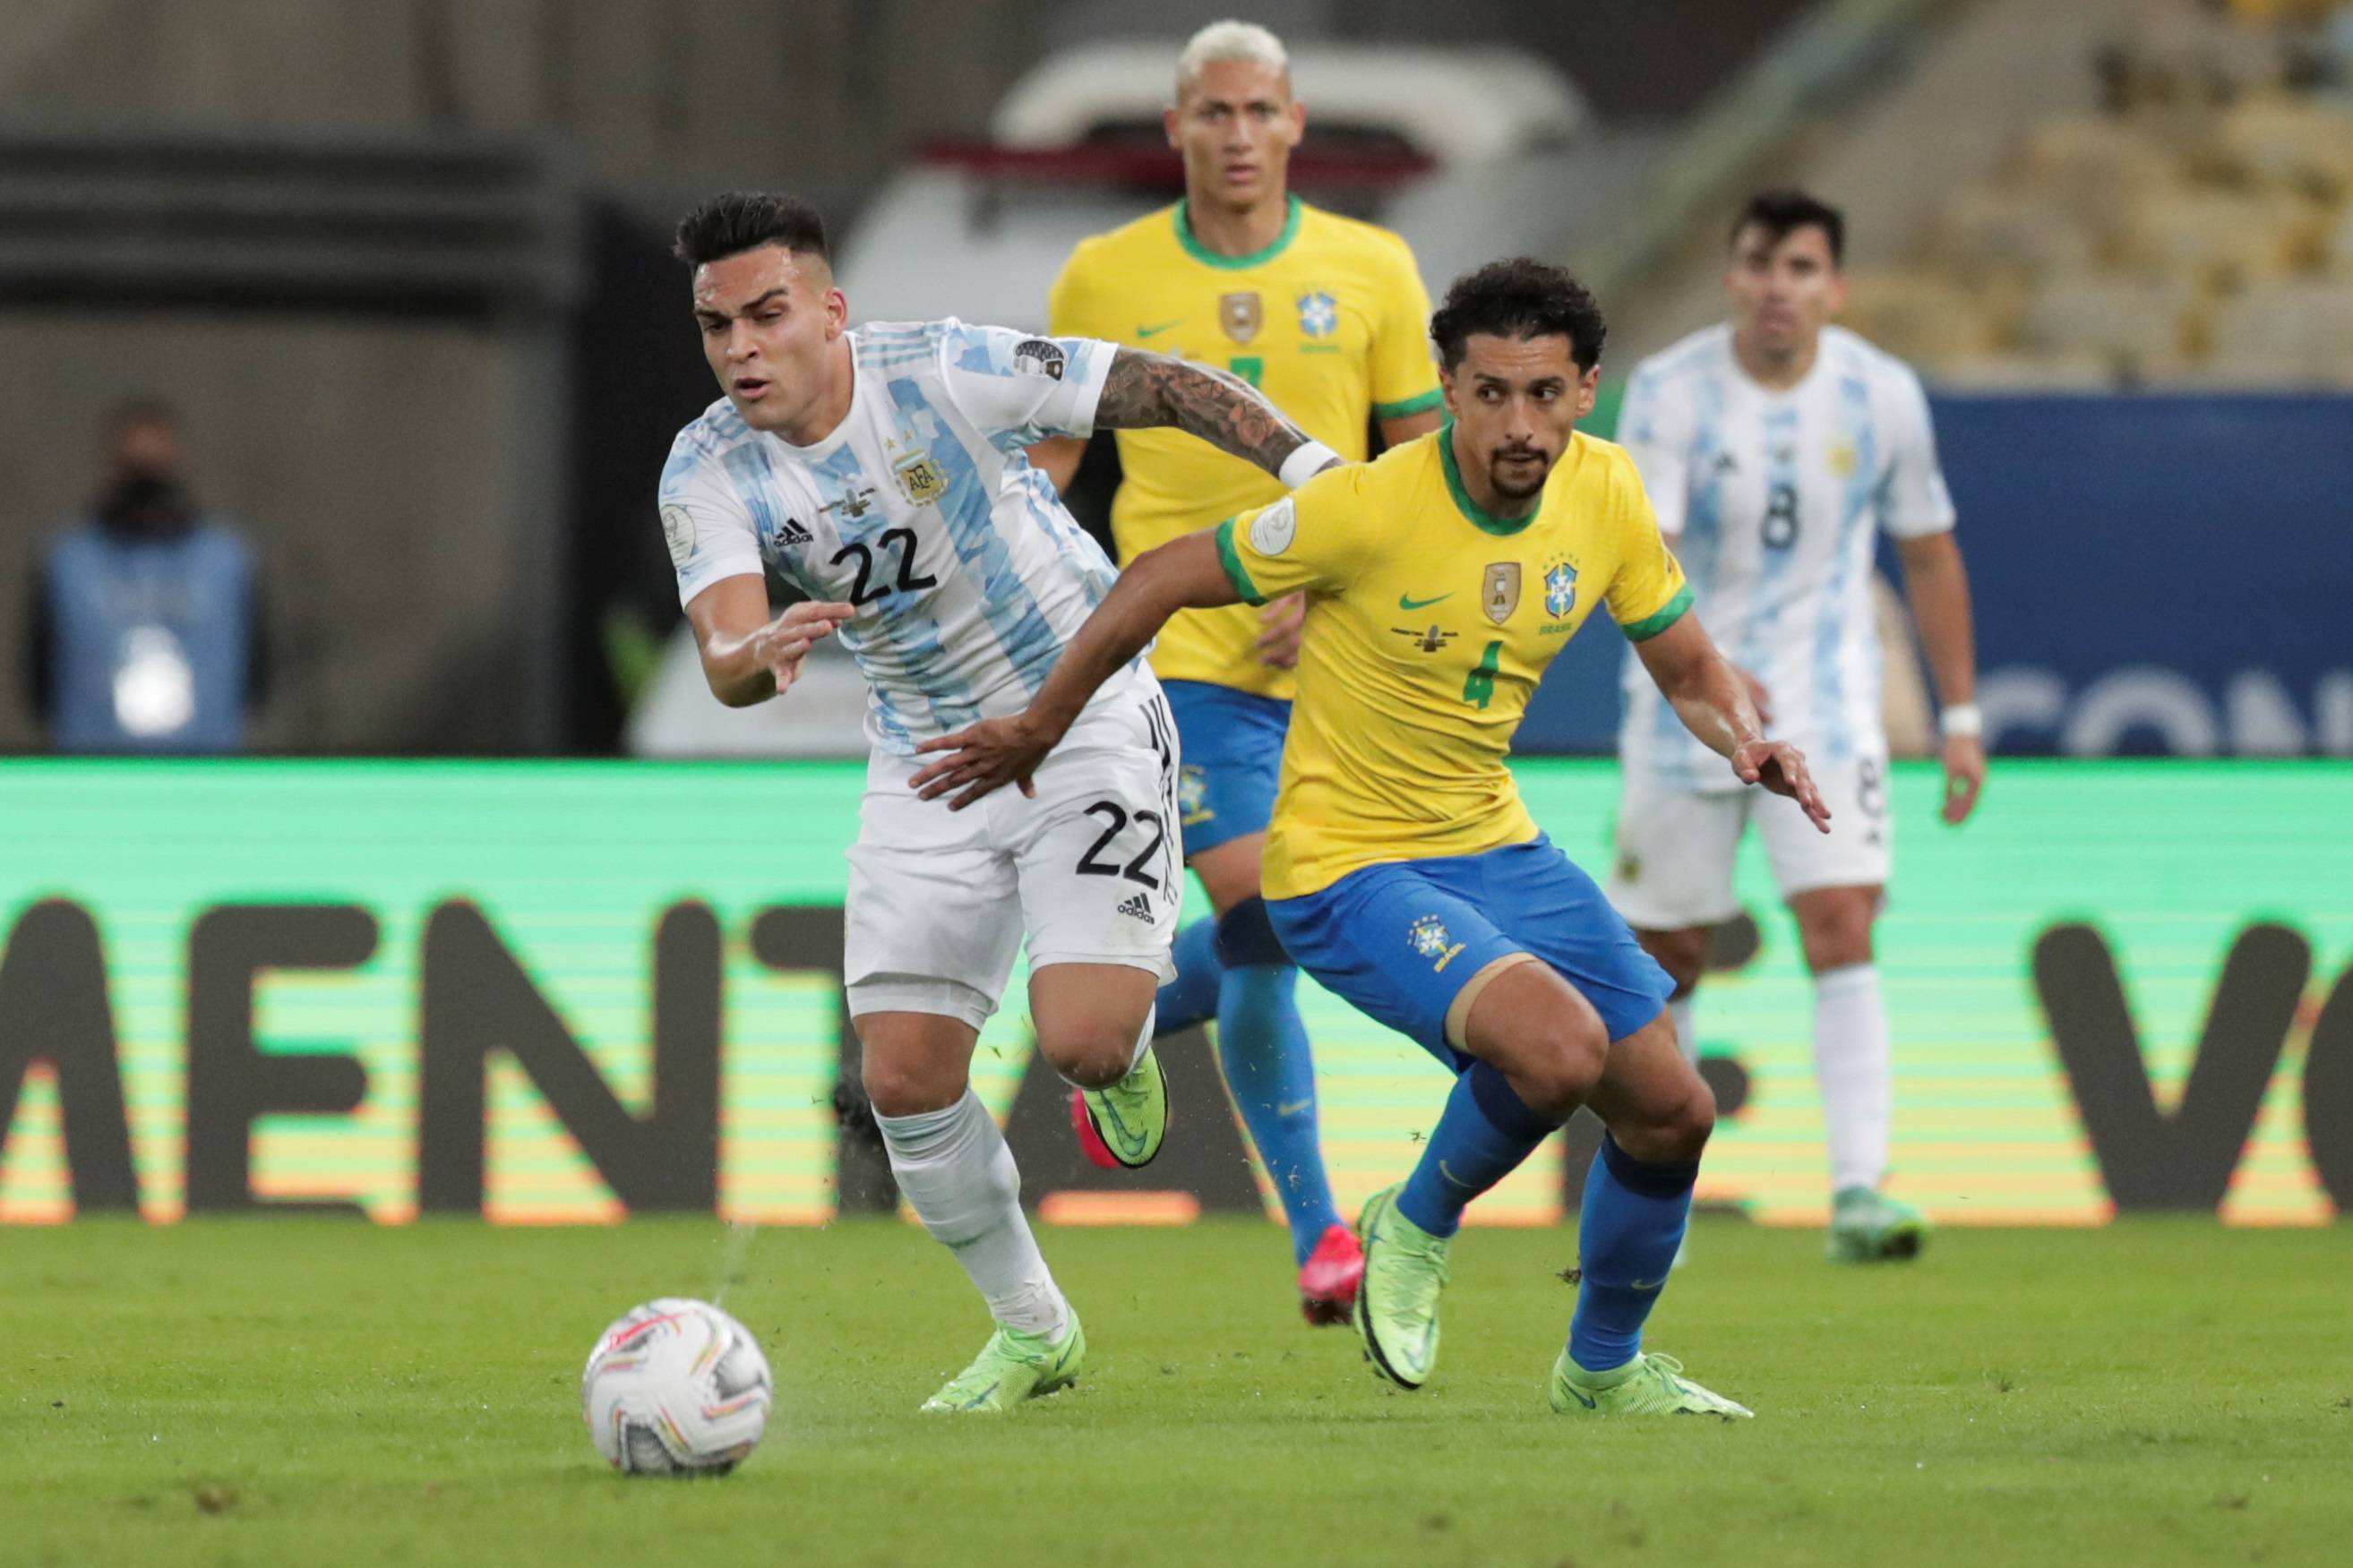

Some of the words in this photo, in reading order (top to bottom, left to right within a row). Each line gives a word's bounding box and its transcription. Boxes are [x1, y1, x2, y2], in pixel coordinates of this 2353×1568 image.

[1761, 483, 1799, 551] 8
[829, 527, 938, 607] 22
[1462, 640, 1504, 710] 4
[1076, 801, 1164, 890] 22
[1117, 904, 1155, 925] adidas
[2034, 921, 2353, 1212] V
